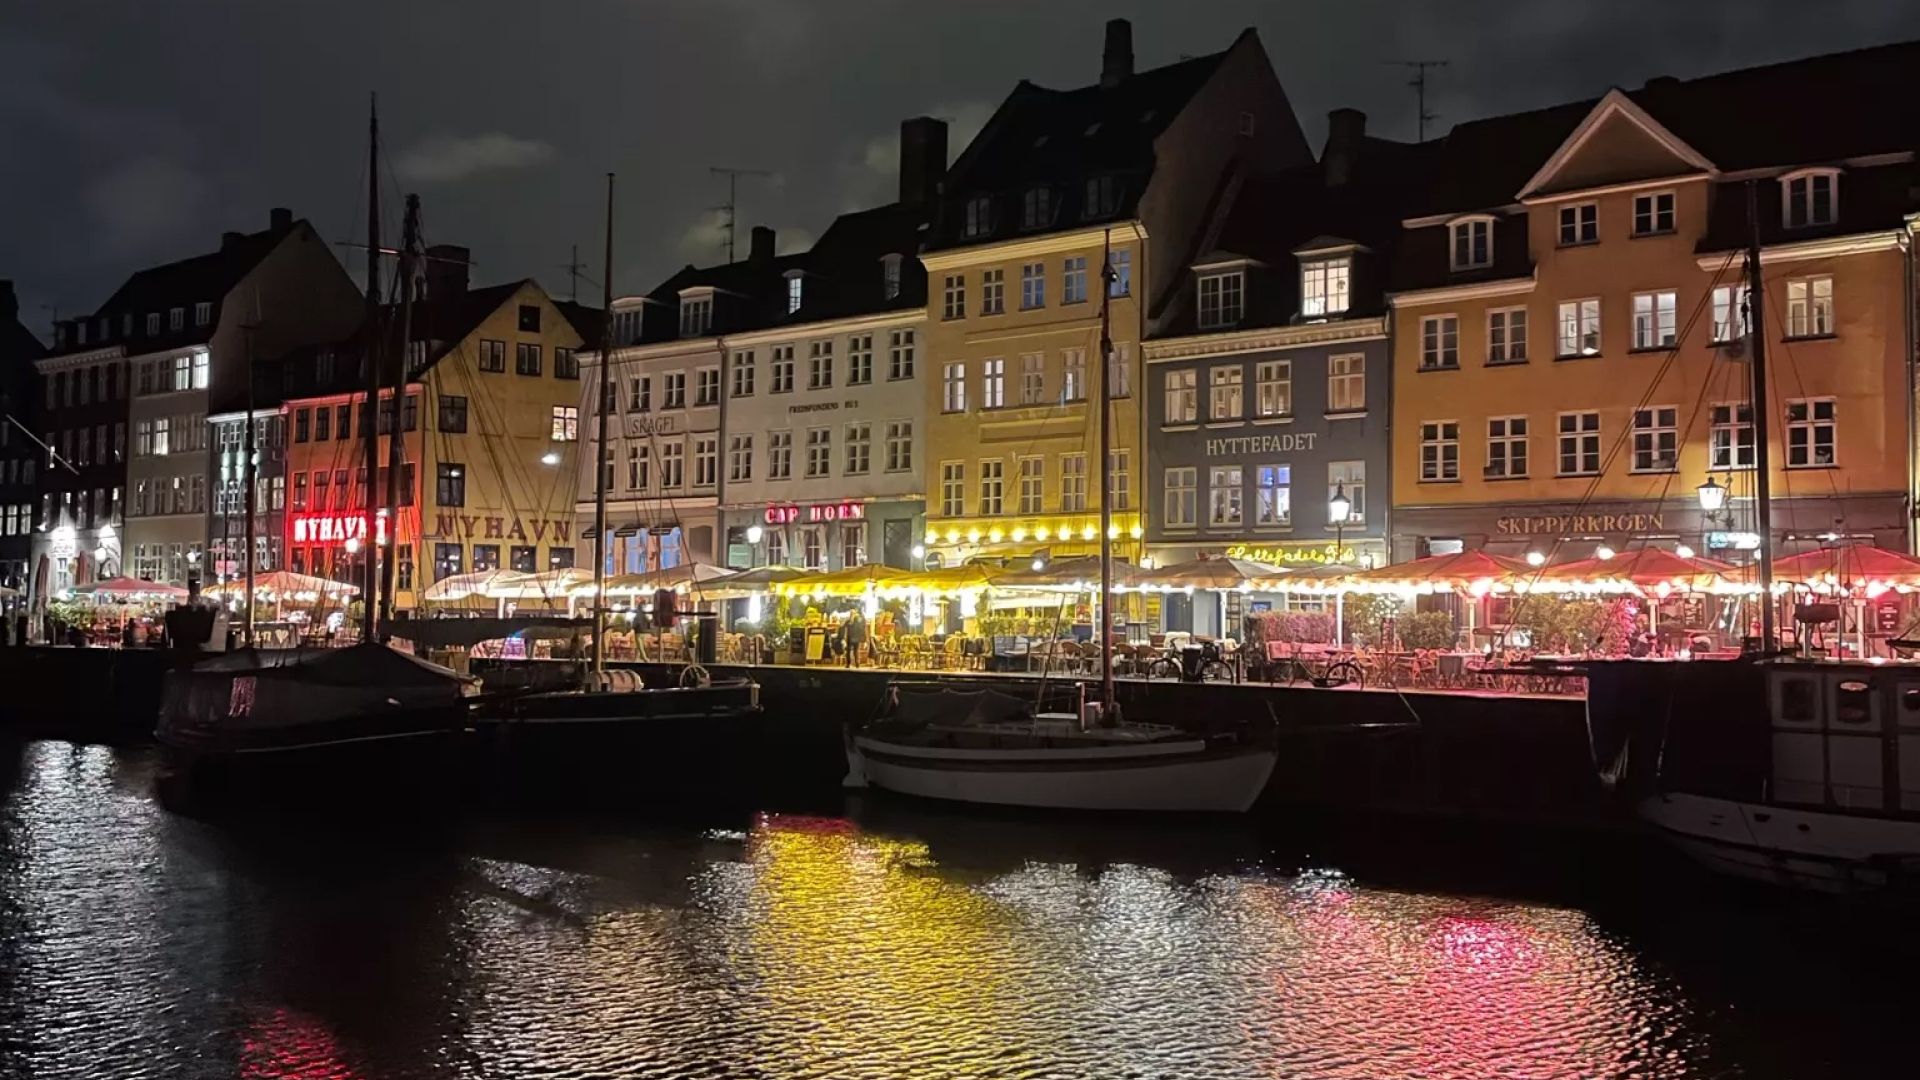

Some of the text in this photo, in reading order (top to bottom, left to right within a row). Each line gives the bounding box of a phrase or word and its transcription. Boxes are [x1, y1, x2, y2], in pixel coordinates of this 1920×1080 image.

[1206, 432, 1317, 456] HYTTEFADET
[764, 503, 865, 523] CAP HORN
[435, 513, 571, 542] NYHAVN
